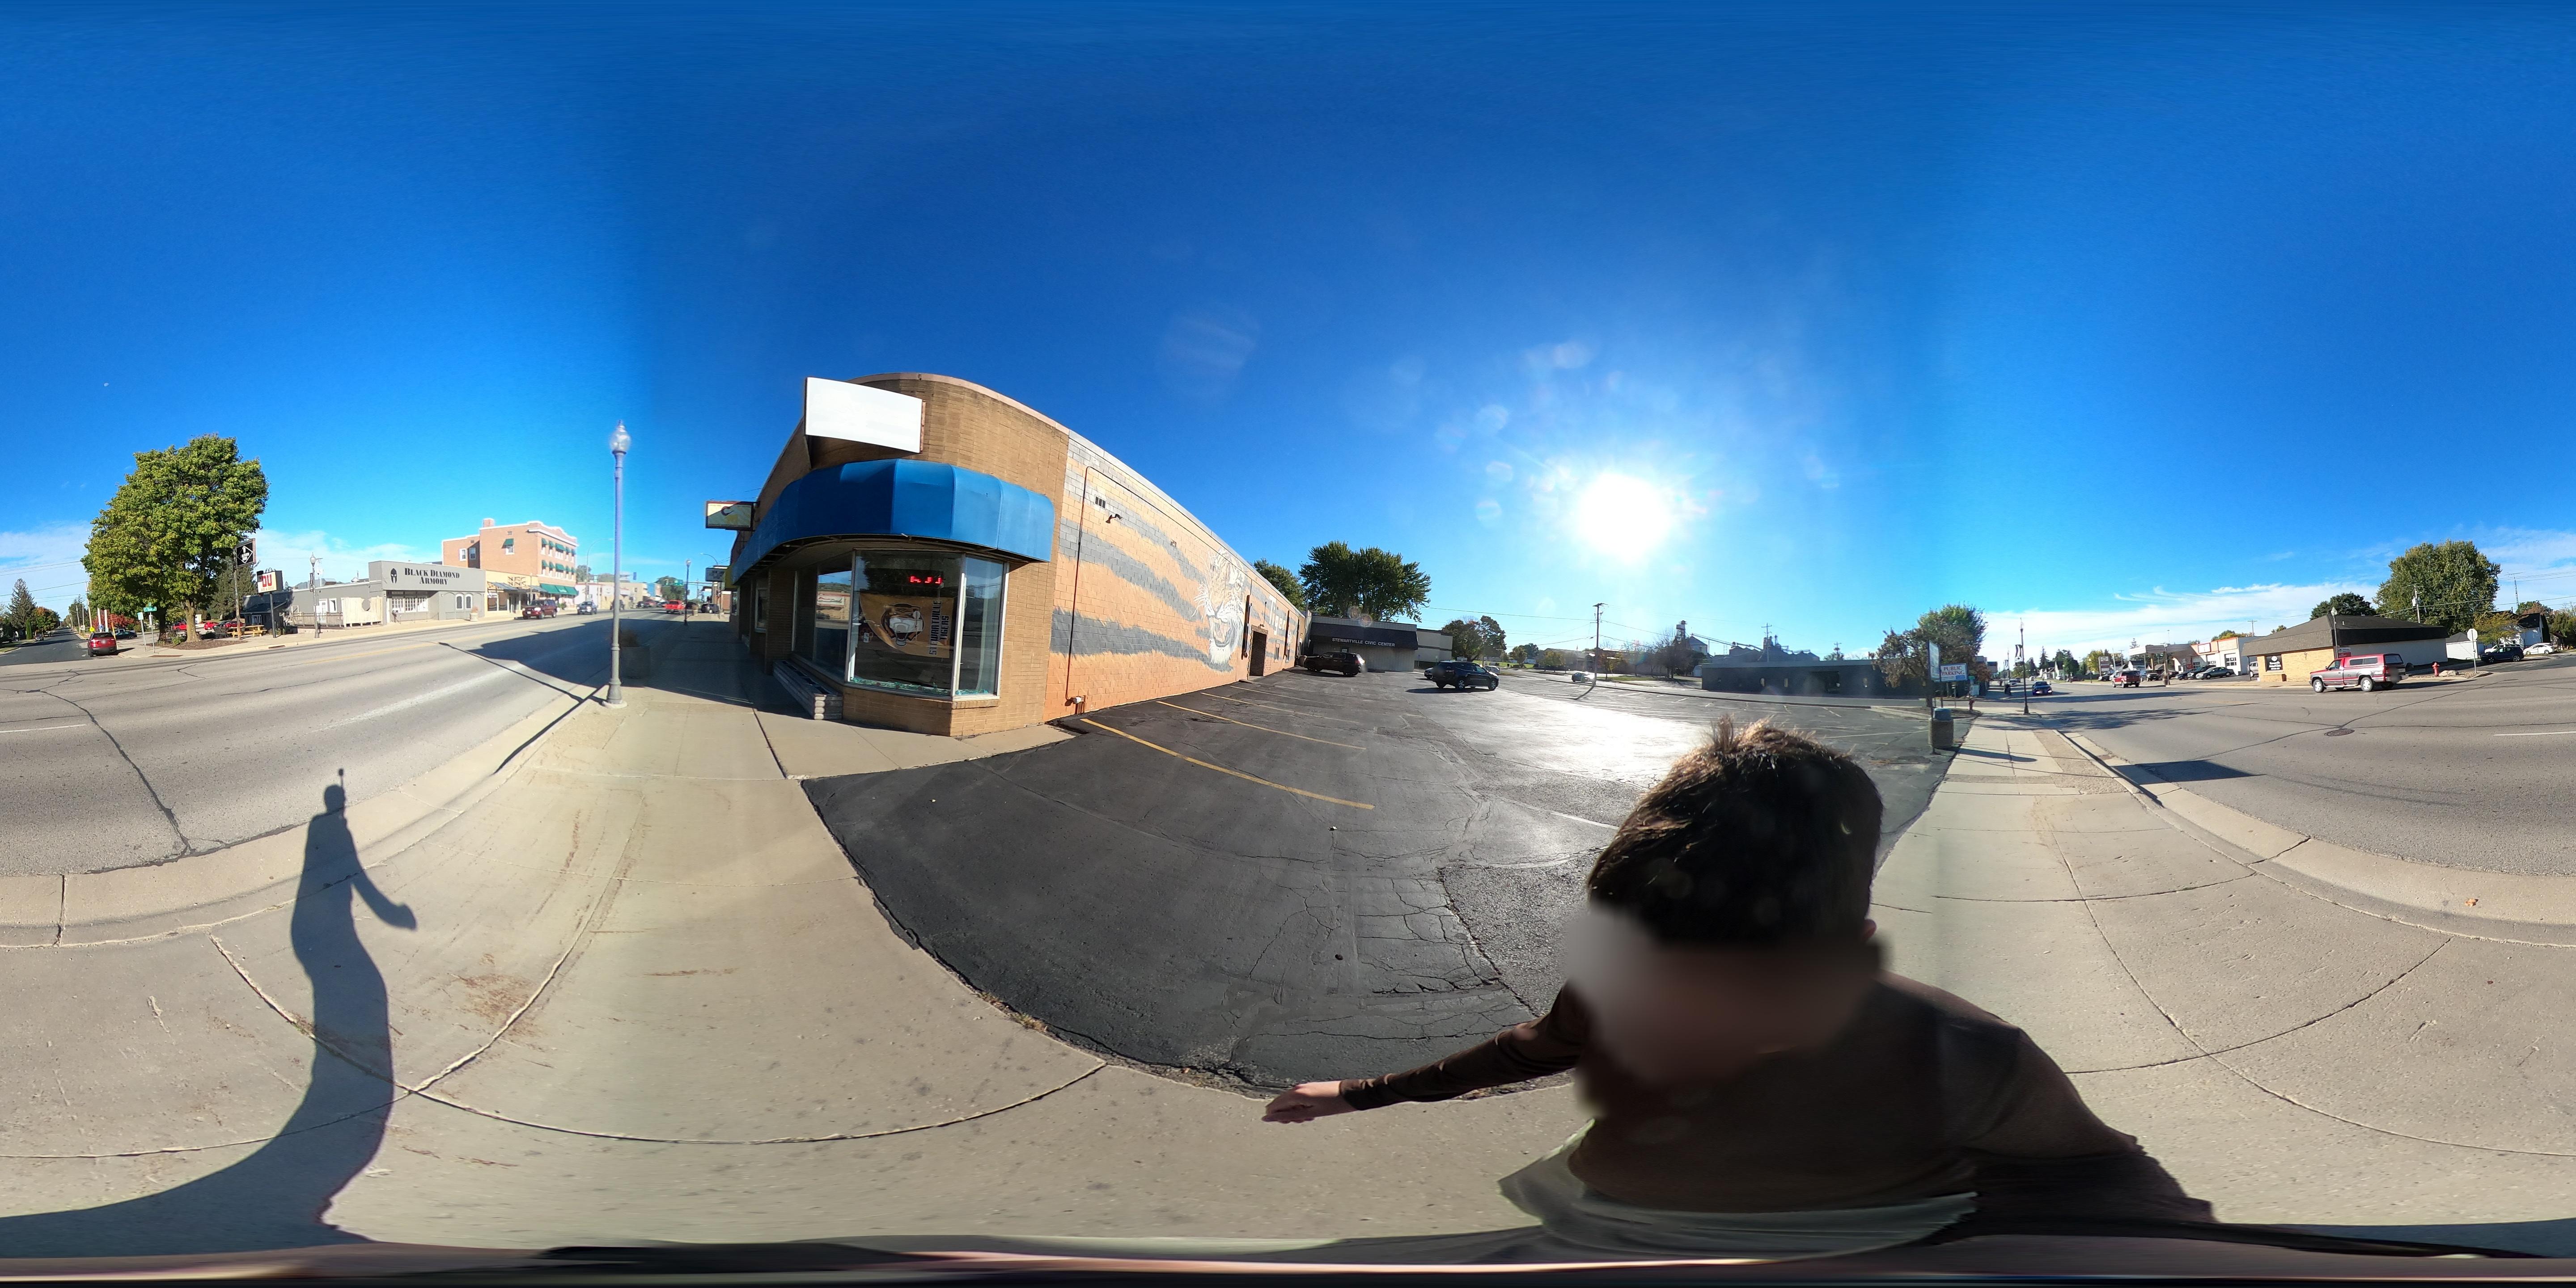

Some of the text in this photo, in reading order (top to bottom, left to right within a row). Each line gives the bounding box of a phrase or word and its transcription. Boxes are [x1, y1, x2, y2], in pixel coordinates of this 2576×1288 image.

[405, 568, 459, 578] BLACK DIAMOND
[419, 576, 448, 585] ARMORY
[1269, 594, 1286, 635] Tiger
[940, 615, 949, 640] TIGERS
